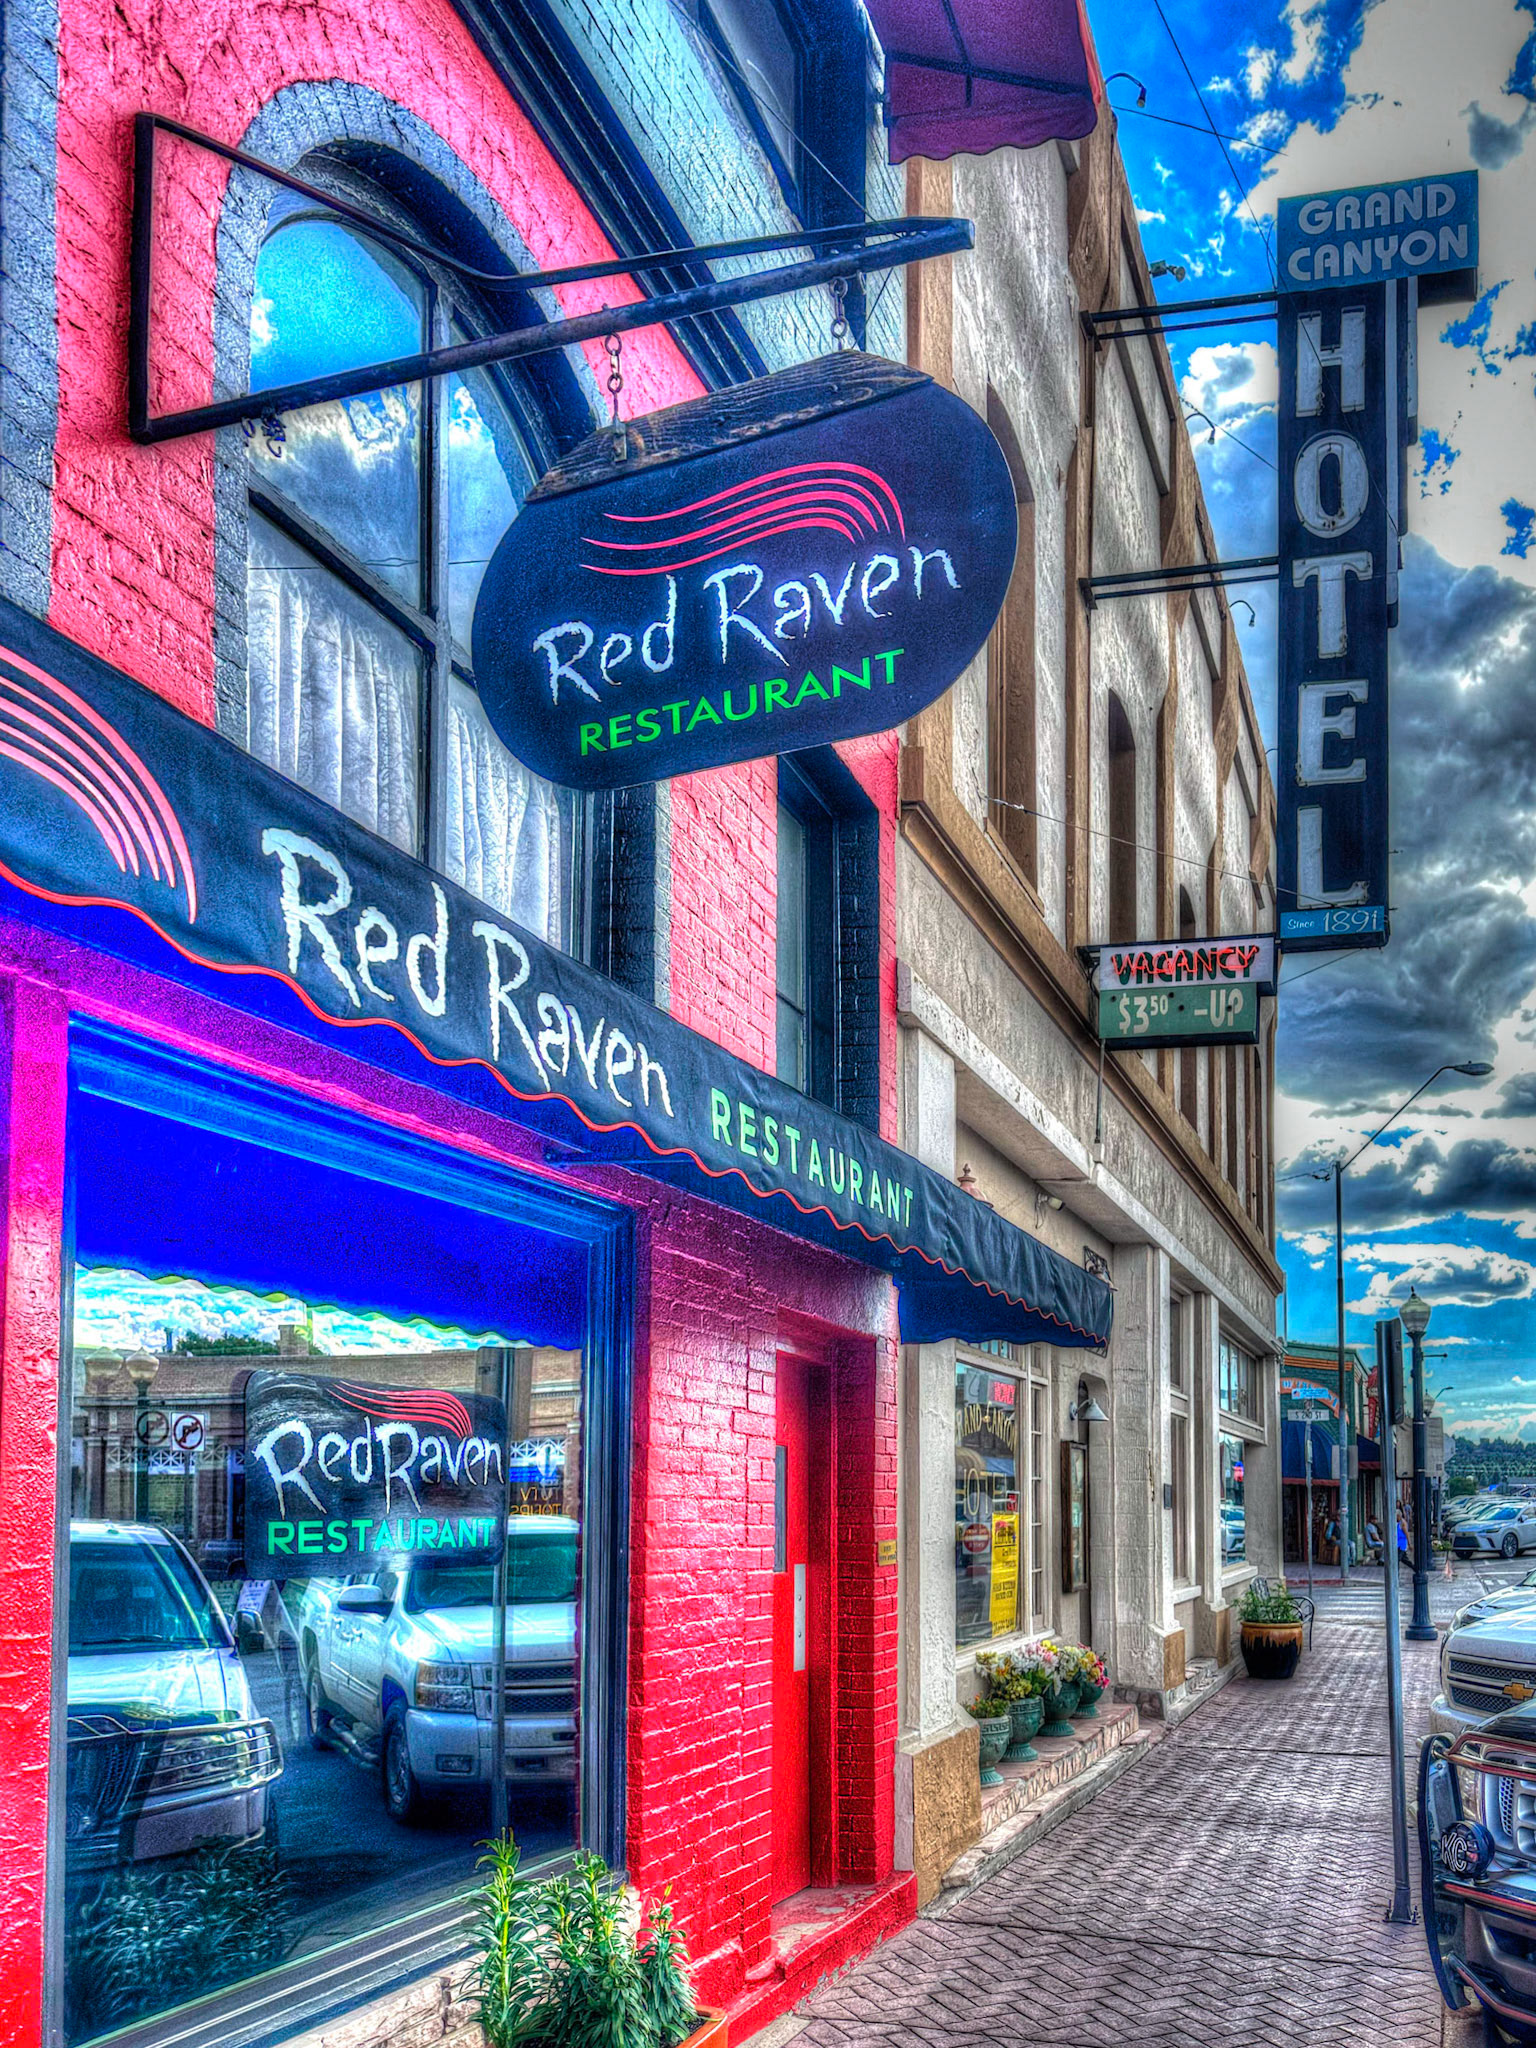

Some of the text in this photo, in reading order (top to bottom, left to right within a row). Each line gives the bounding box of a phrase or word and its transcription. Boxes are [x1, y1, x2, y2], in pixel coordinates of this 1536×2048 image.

[1298, 182, 1456, 236] GRAND
[1287, 223, 1469, 282] CANYON
[532, 545, 962, 706] Red Raven
[1292, 305, 1373, 909] HOTEL
[579, 647, 905, 757] RESTAURANT
[1286, 909, 1378, 933] Since 1891
[1111, 945, 1259, 986] VACANCY
[261, 827, 915, 1229] Red Raven RESTAURANT
[251, 1415, 506, 1518] Red Raven
[267, 1516, 498, 1556] RESTAURANT
[1441, 1832, 1468, 1872] KC
